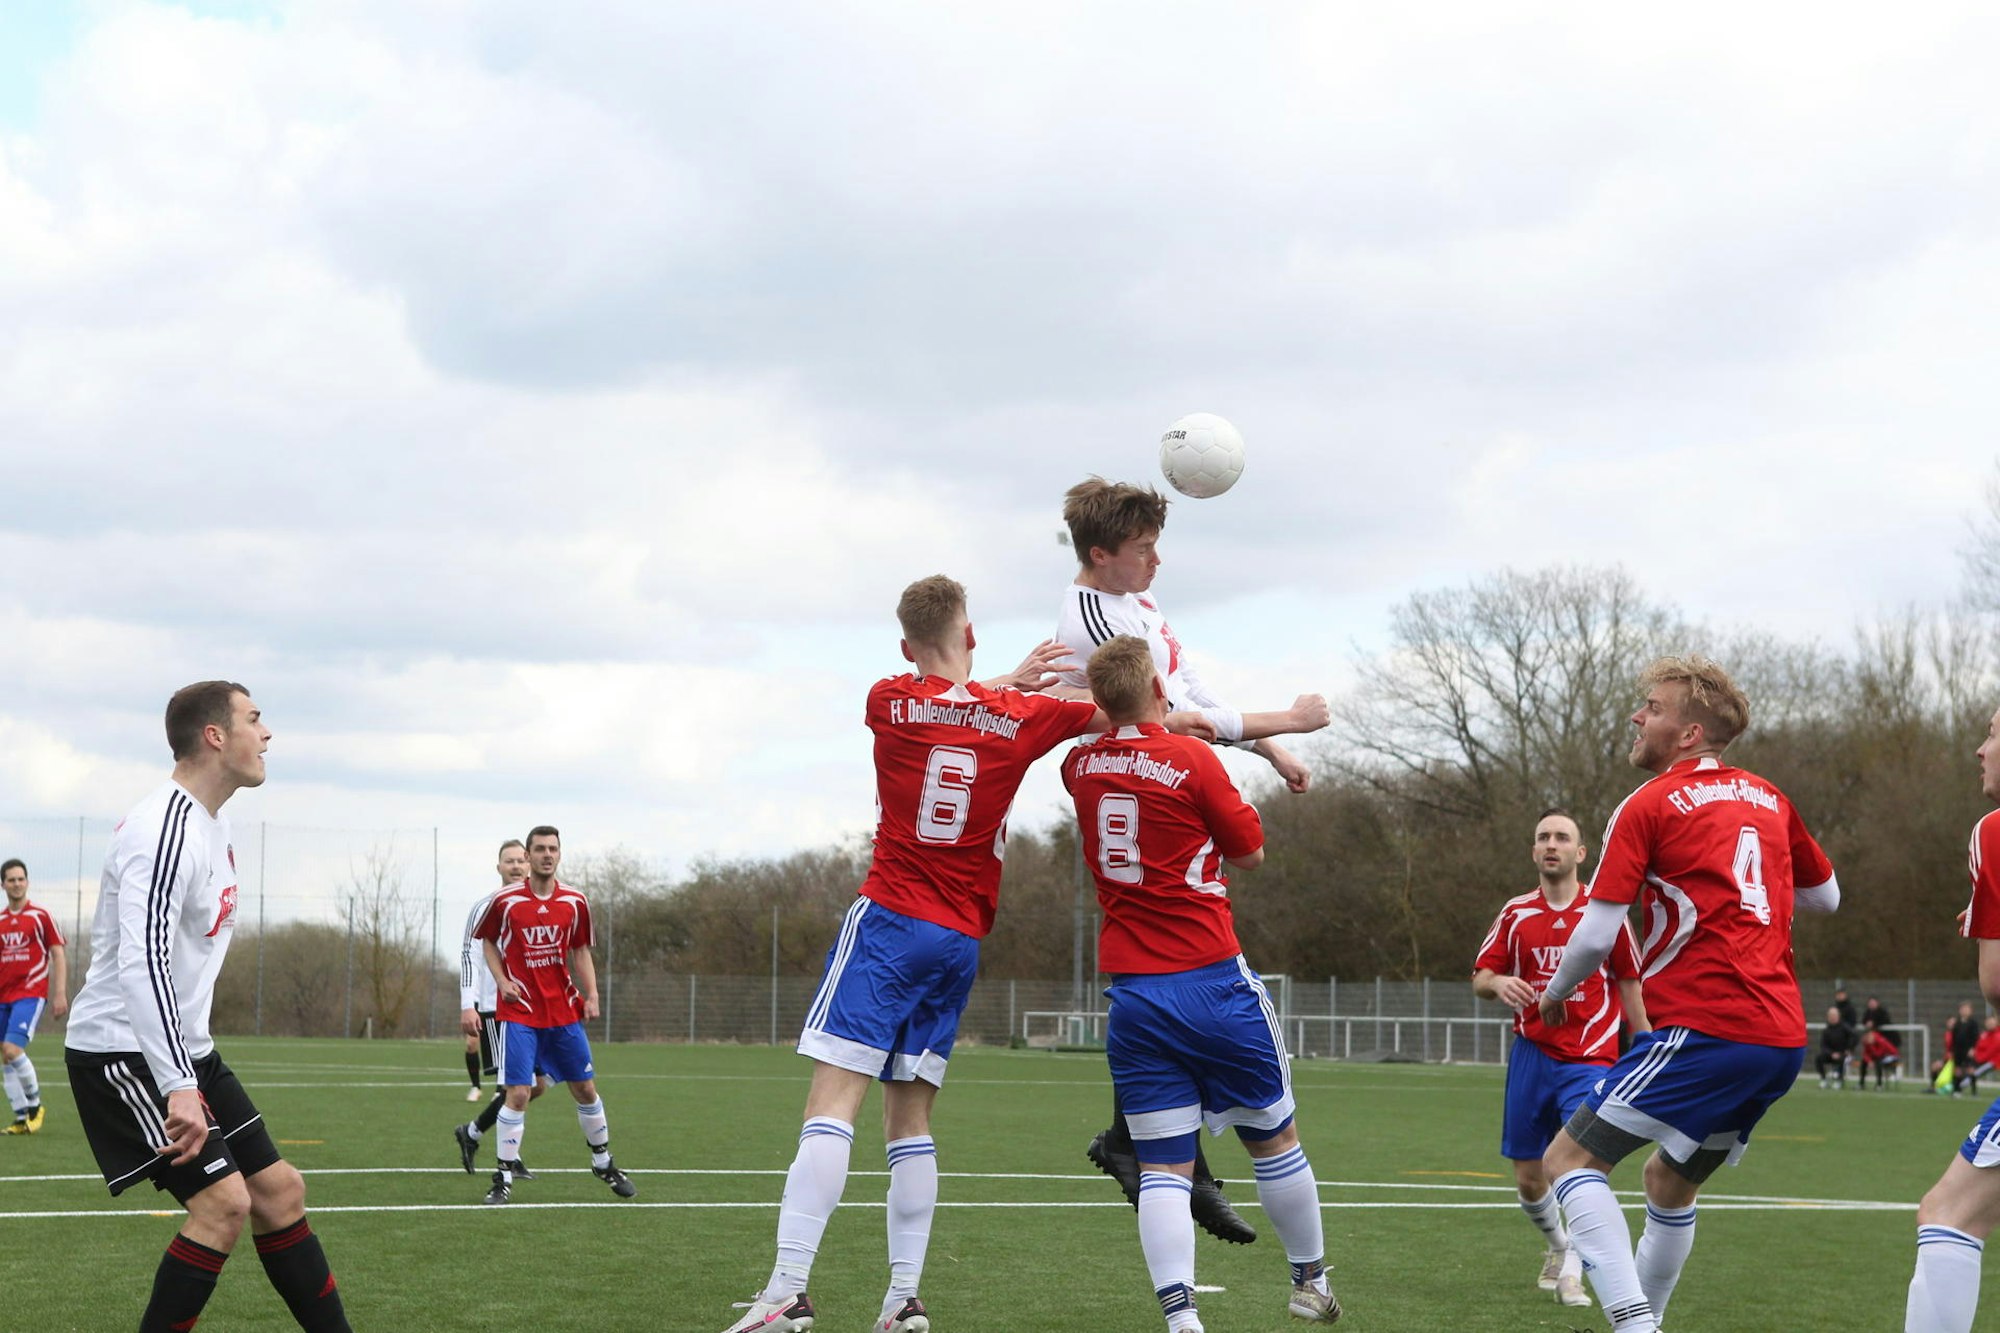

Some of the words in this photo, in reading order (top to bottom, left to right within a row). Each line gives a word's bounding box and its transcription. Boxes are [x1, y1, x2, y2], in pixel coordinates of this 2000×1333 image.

[890, 699, 904, 725] FC
[1086, 750, 1190, 790] Dollendorf-Ripsdorf
[916, 744, 977, 844] 6
[1667, 790, 1692, 815] FC
[1097, 793, 1144, 885] 8
[1732, 826, 1771, 925] 4
[1, 932, 25, 946] VPV
[521, 925, 559, 945] VPV
[1531, 946, 1566, 970] VP
